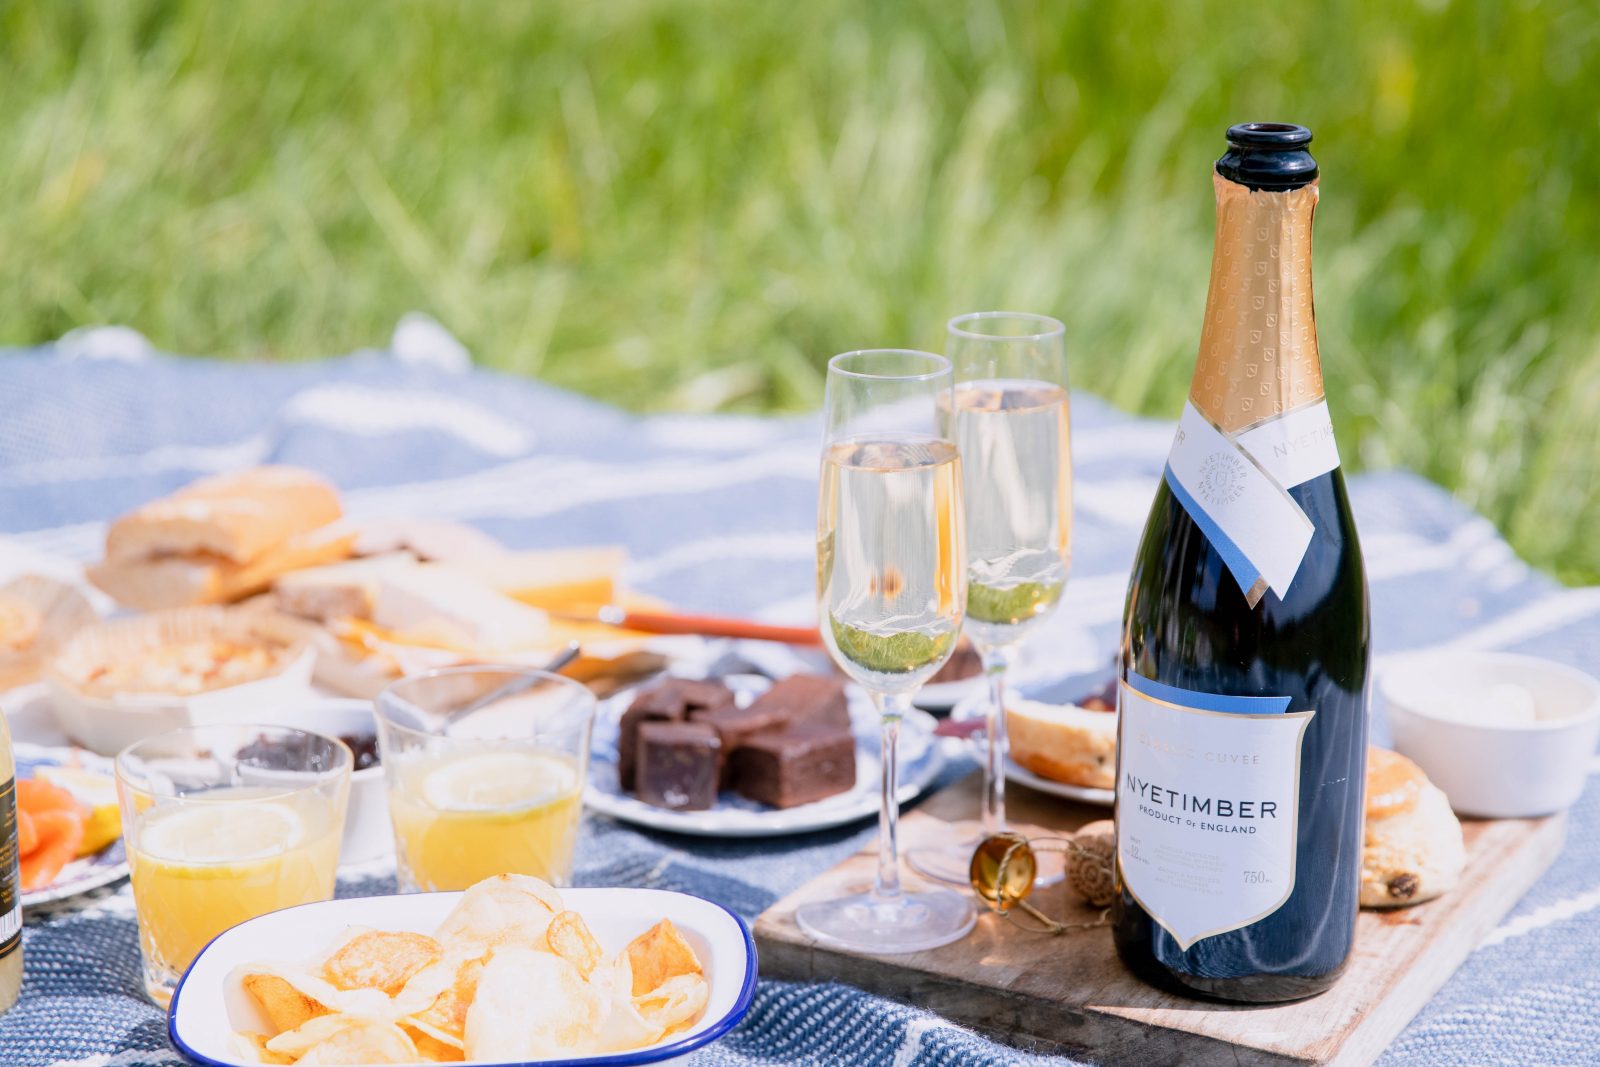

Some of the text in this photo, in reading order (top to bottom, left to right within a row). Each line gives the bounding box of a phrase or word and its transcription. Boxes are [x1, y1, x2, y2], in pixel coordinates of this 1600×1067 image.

[1127, 772, 1278, 819] NYETIMBER
[1139, 804, 1182, 825] PRODUCT
[1200, 822, 1257, 834] ENGLAND
